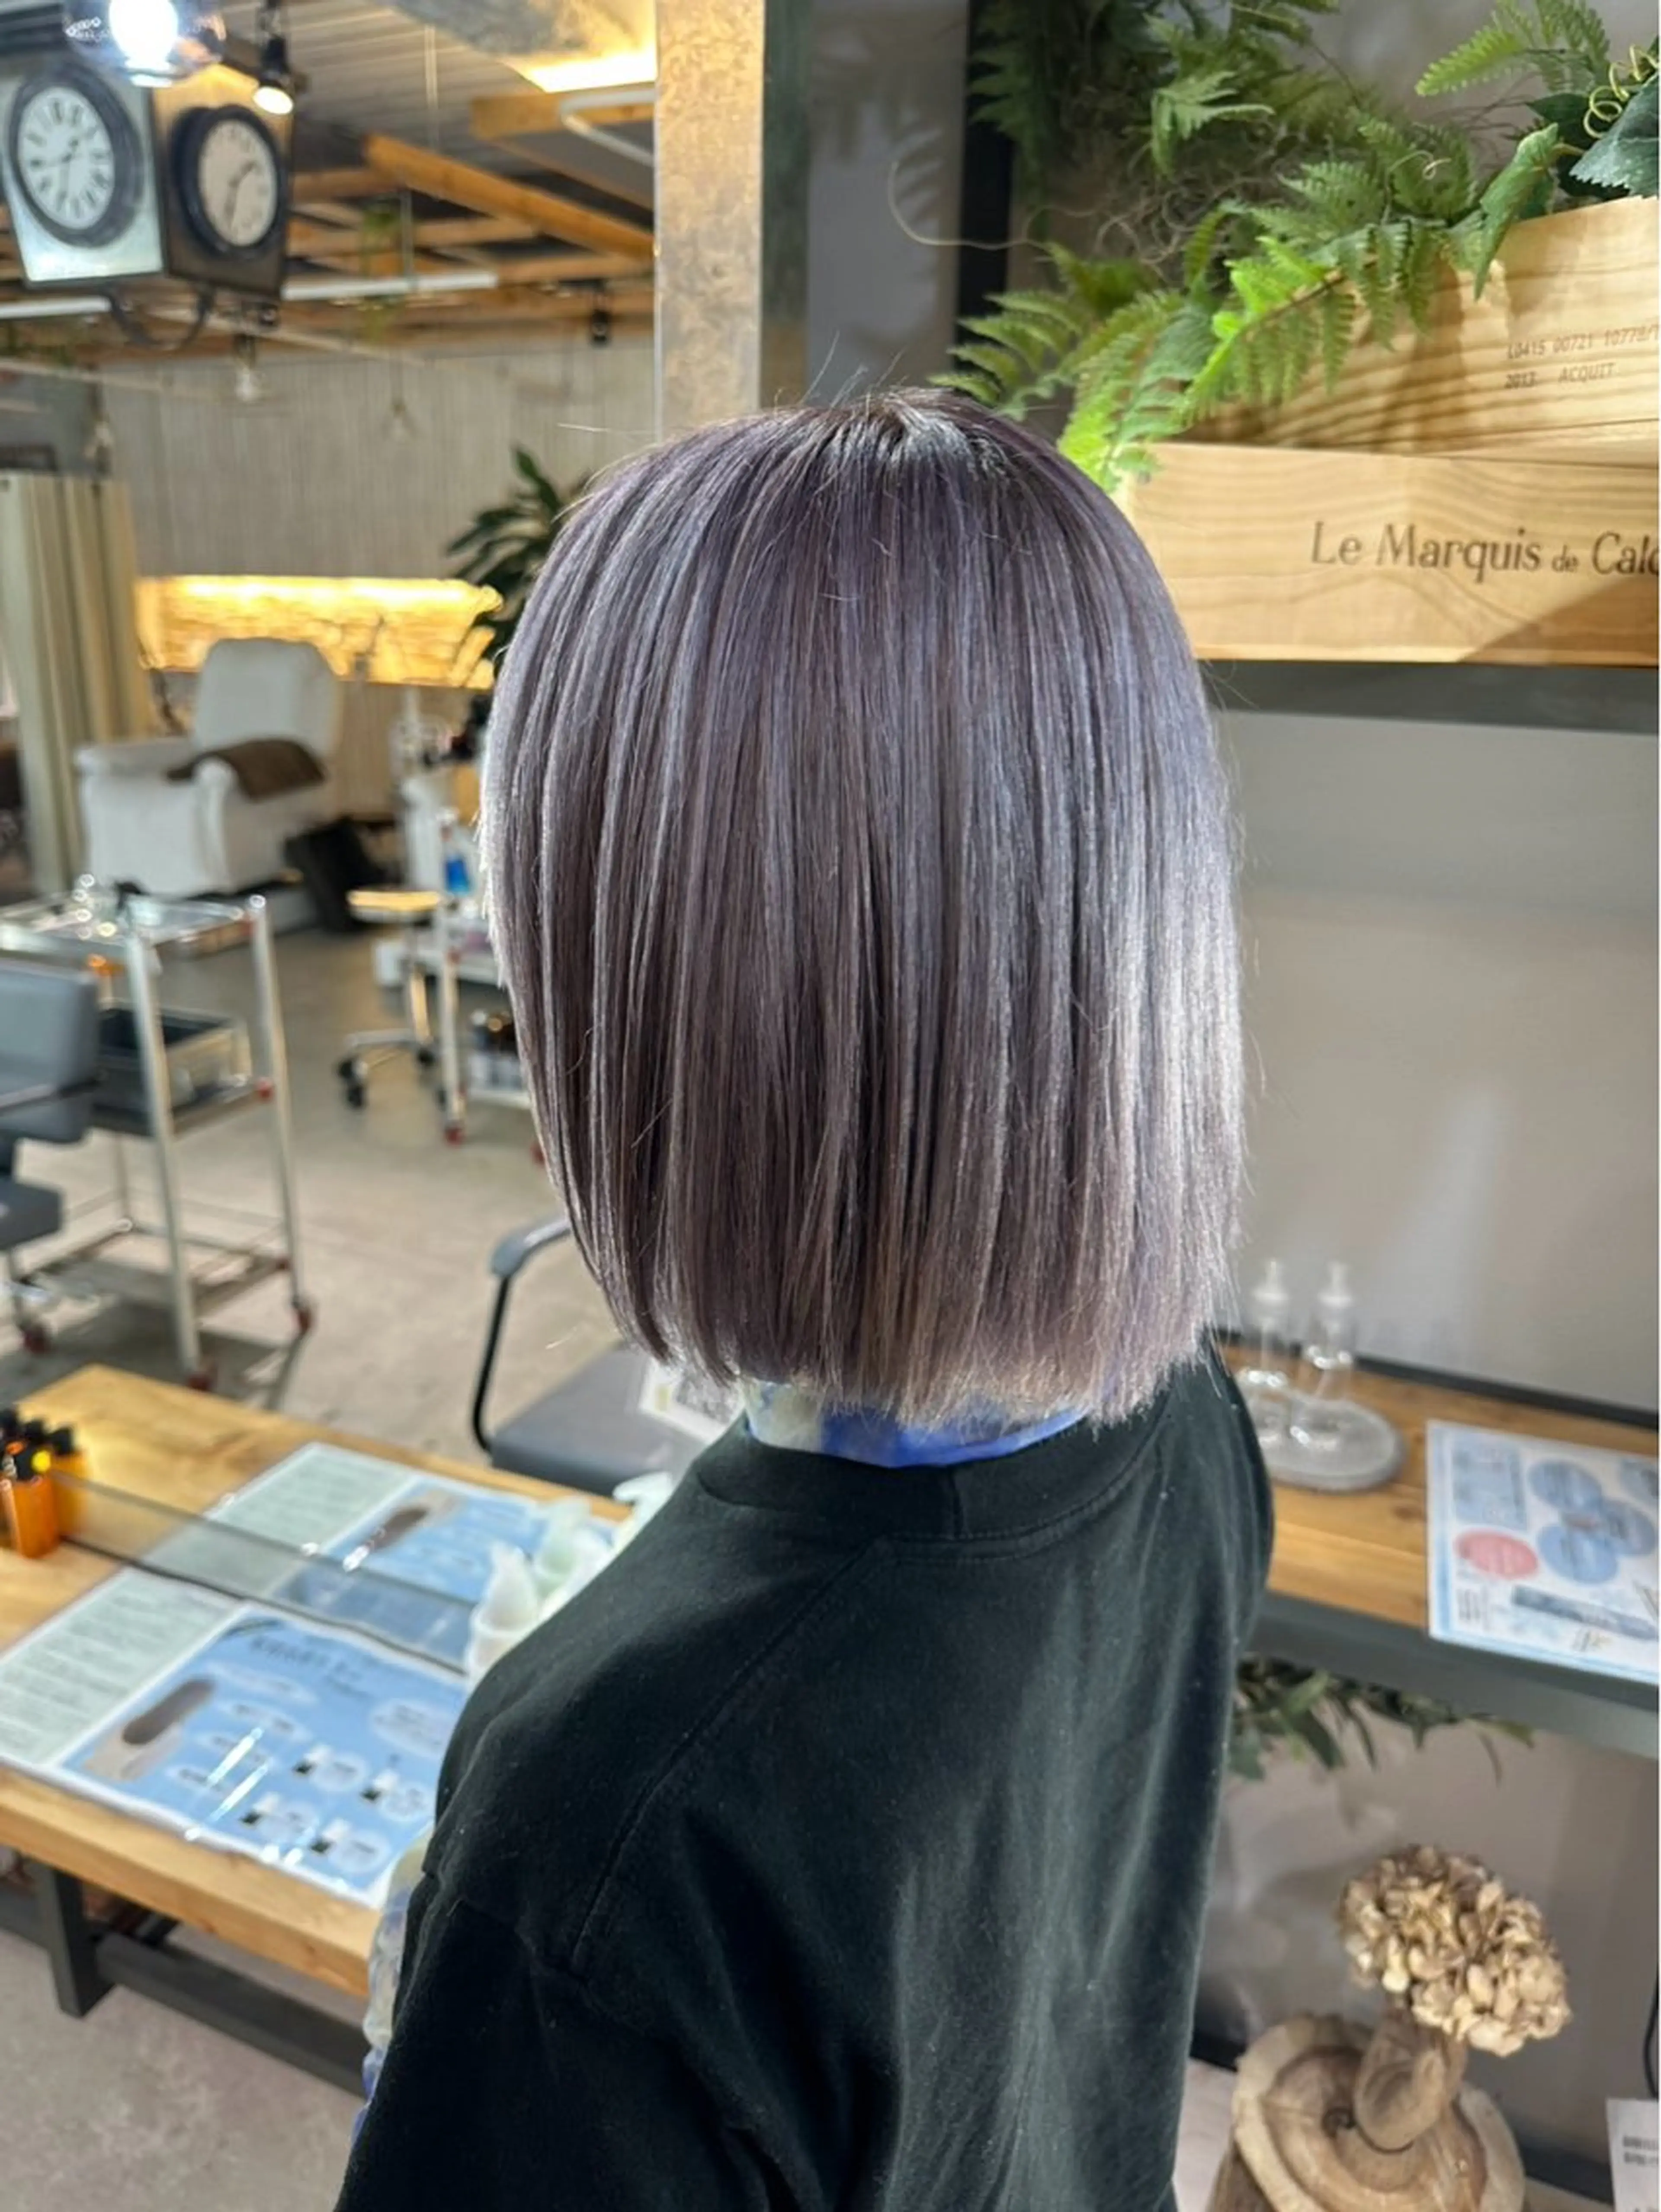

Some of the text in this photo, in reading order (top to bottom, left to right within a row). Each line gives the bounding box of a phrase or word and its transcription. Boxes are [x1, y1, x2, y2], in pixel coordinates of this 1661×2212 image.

[1558, 362, 1616, 384] ACQUIT
[1311, 520, 1363, 566] Le
[1376, 523, 1542, 584] Marquis
[1551, 545, 1580, 574] de
